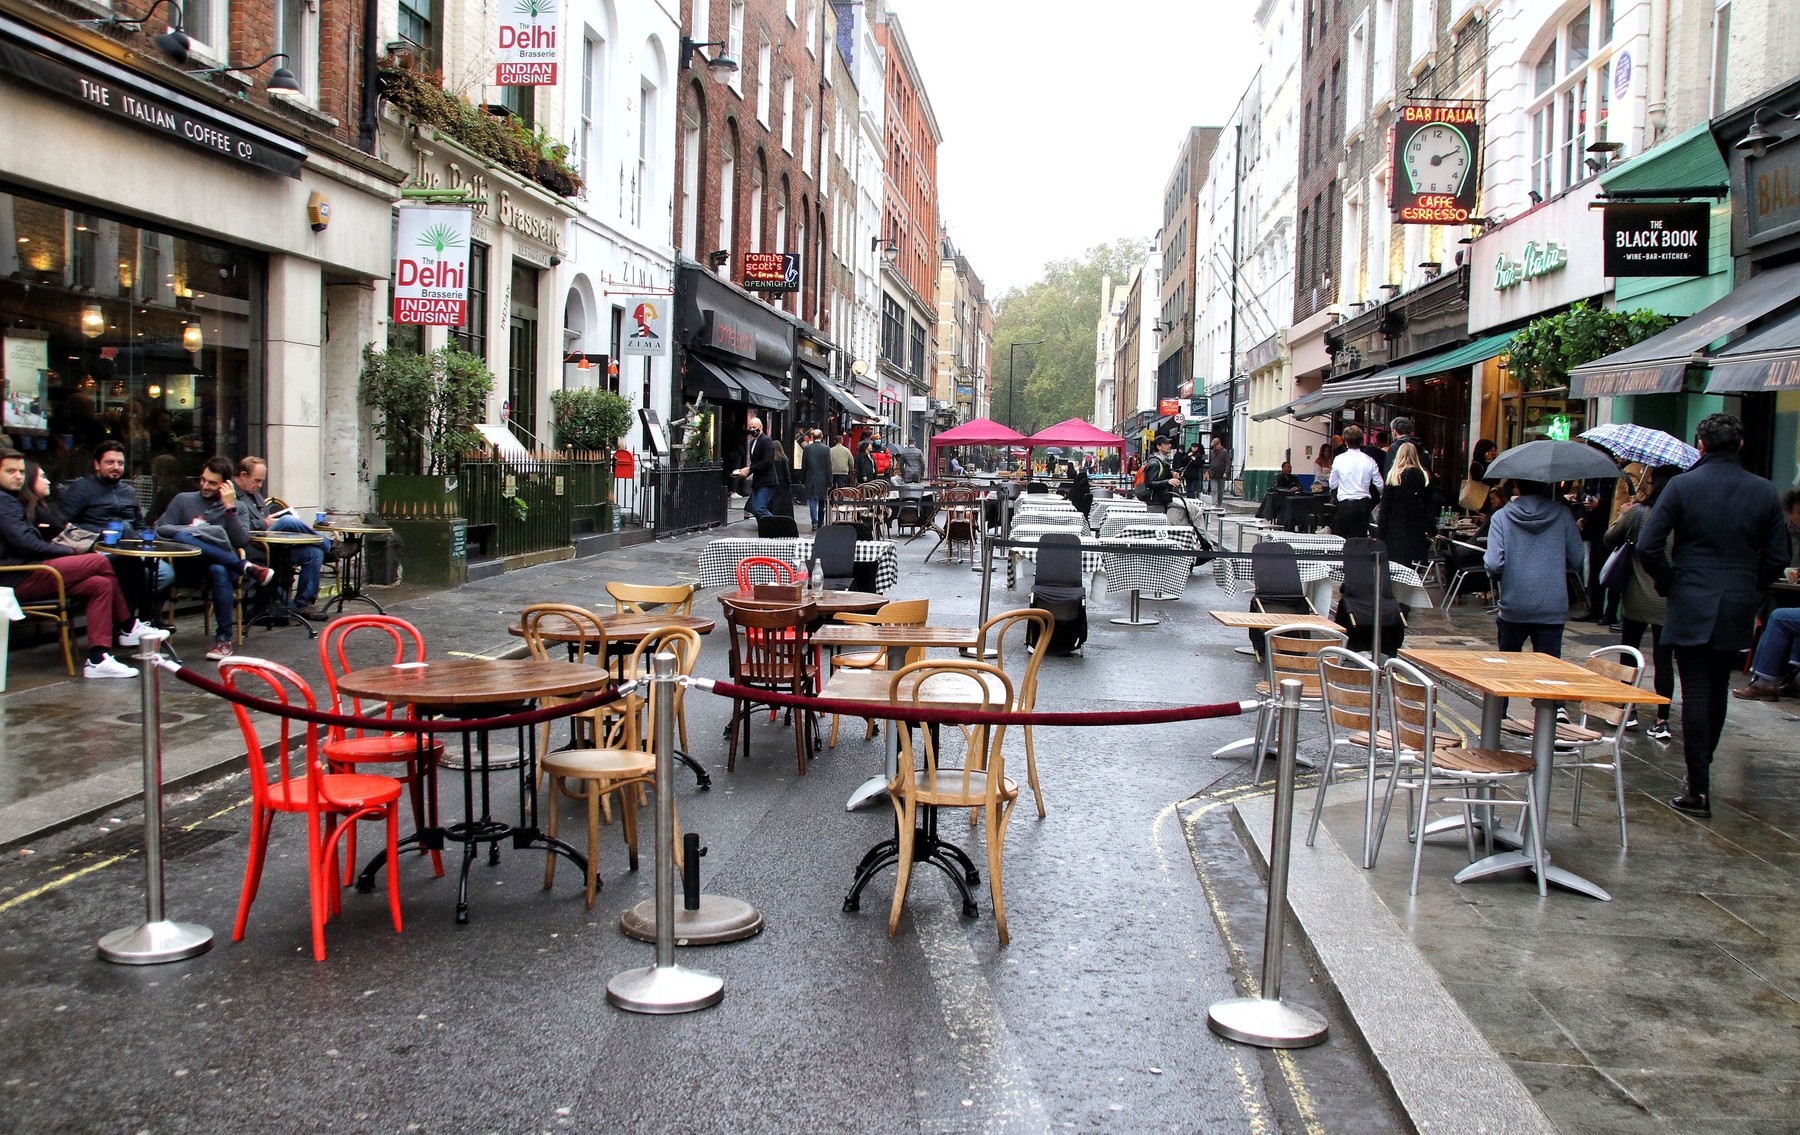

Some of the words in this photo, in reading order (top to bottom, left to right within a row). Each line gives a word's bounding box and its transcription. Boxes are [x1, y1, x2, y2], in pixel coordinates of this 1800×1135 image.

[519, 22, 530, 30] The
[499, 25, 556, 49] Delhi
[519, 50, 556, 58] Brasserie
[501, 63, 552, 74] INDIAN
[501, 74, 552, 84] CUISINE
[80, 78, 110, 106] THE
[122, 95, 176, 130] ITALIAN
[184, 120, 231, 151] COFFEE
[1405, 107, 1432, 121] BAR
[1435, 108, 1475, 122] ITALIA
[1421, 134, 1427, 142] 11
[1433, 130, 1443, 139] 12
[1449, 135, 1453, 143] 1
[1412, 143, 1421, 151] 10
[1409, 155, 1414, 163] 9
[1458, 158, 1464, 166] 3
[1411, 169, 1418, 177] 8
[1452, 172, 1458, 180] 4
[1430, 183, 1436, 191] 6
[1446, 184, 1452, 192] 5
[1418, 195, 1455, 209] CAFFE
[499, 190, 561, 249] Brasserie
[1650, 220, 1663, 229] THE
[1616, 230, 1659, 248] BLACK
[1661, 230, 1698, 247] BOOK
[517, 244, 547, 266] RESTAURANT
[746, 253, 783, 263] ronnie
[422, 256, 435, 266] The
[1494, 253, 1516, 289] Bar
[1521, 241, 1561, 281] Italia
[746, 262, 782, 271] scott's
[398, 259, 465, 289] Delhi
[623, 261, 654, 293] ZIMA
[744, 280, 766, 288] OPEN
[421, 289, 464, 299] Brasserie
[400, 299, 460, 313] INDIAN
[500, 284, 511, 331] INDIAN
[400, 311, 460, 324] CUISINE
[628, 340, 662, 349] ZIMA
[1763, 361, 1786, 386] ALL
[1158, 530, 1167, 538] 45
